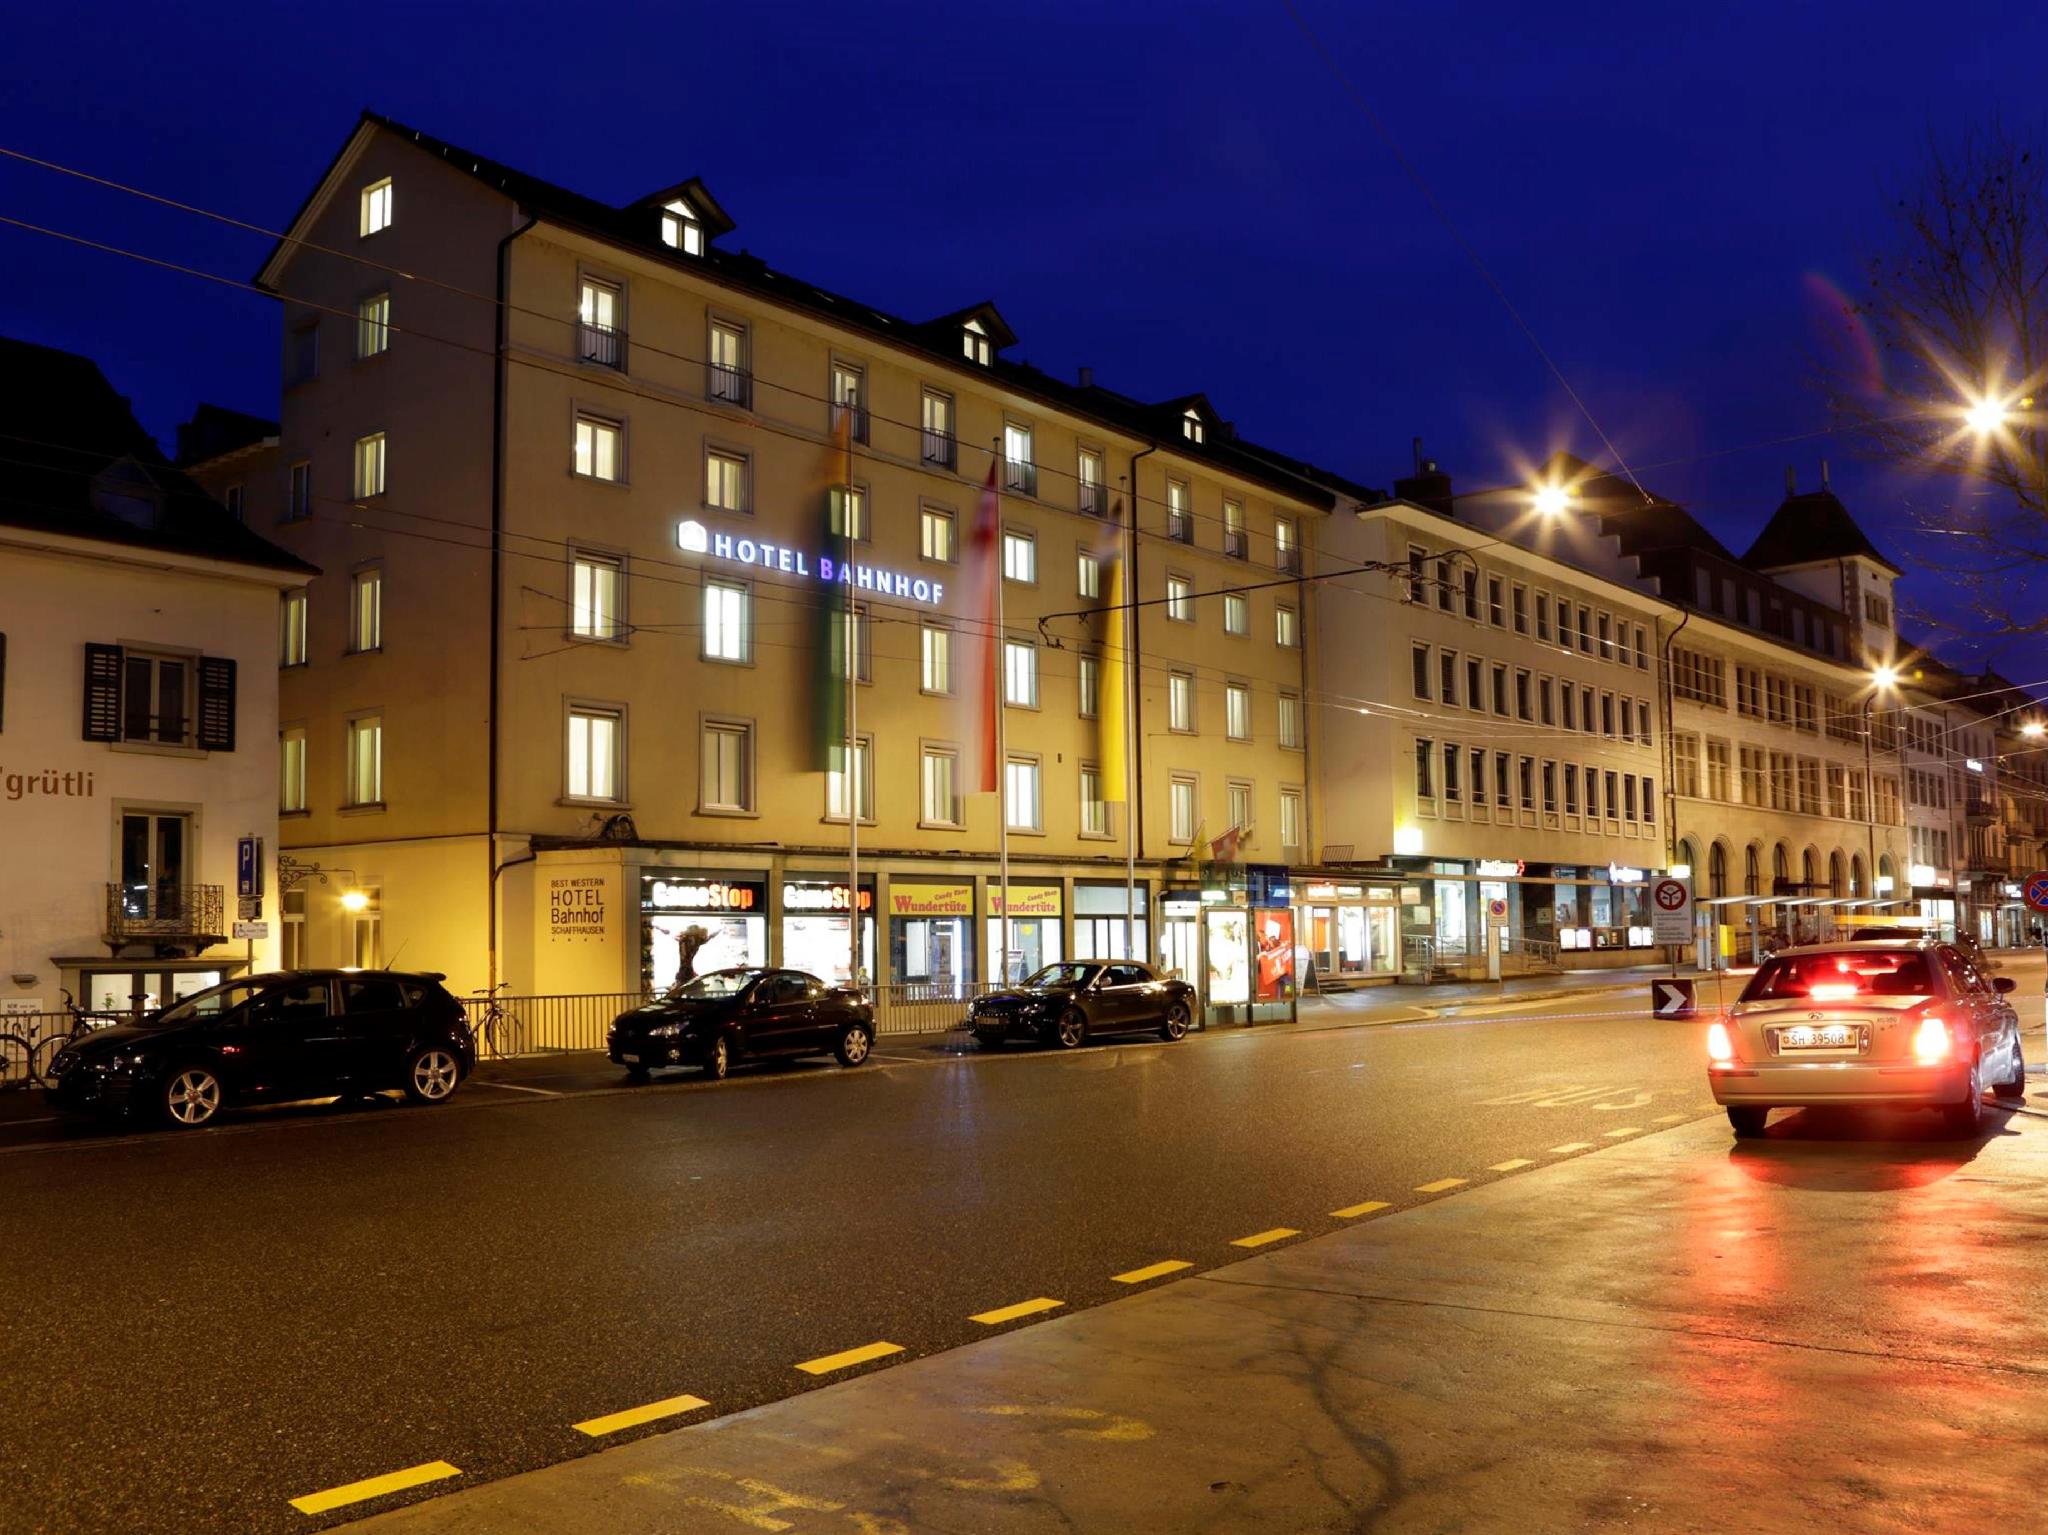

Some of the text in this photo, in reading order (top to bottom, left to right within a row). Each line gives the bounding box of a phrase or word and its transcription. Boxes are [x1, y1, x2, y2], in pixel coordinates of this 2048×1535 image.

[713, 534, 943, 604] HOTEL BAHNHOF
[242, 844, 250, 871] P
[551, 879, 605, 888] BEST WESTERN
[551, 889, 605, 906] HOTEL
[652, 881, 753, 909] GameStop
[894, 895, 967, 913] Wundertüte
[551, 907, 605, 924] Bahnhof
[1791, 1033, 1845, 1045] SH 39508
